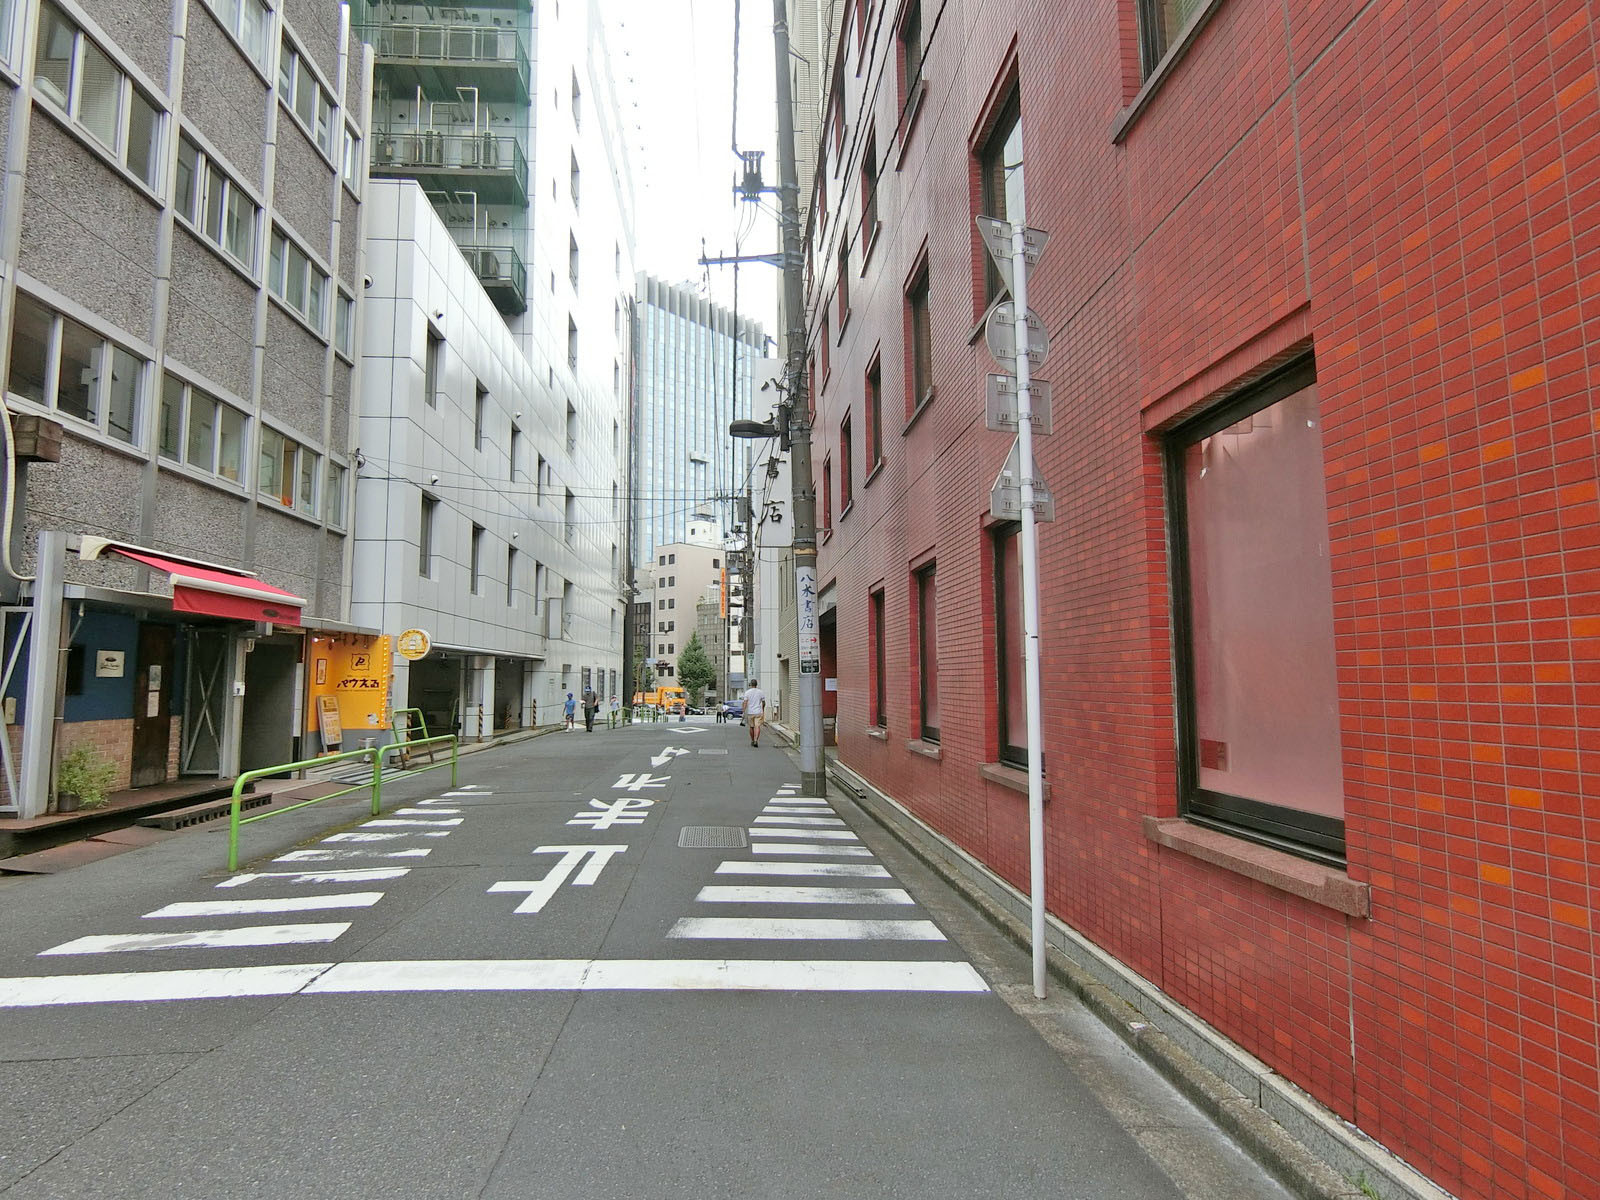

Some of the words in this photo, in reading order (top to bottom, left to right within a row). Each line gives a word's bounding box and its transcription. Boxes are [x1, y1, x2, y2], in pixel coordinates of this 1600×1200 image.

[759, 377, 789, 524] 八書店
[486, 774, 671, 914] 止まれ
